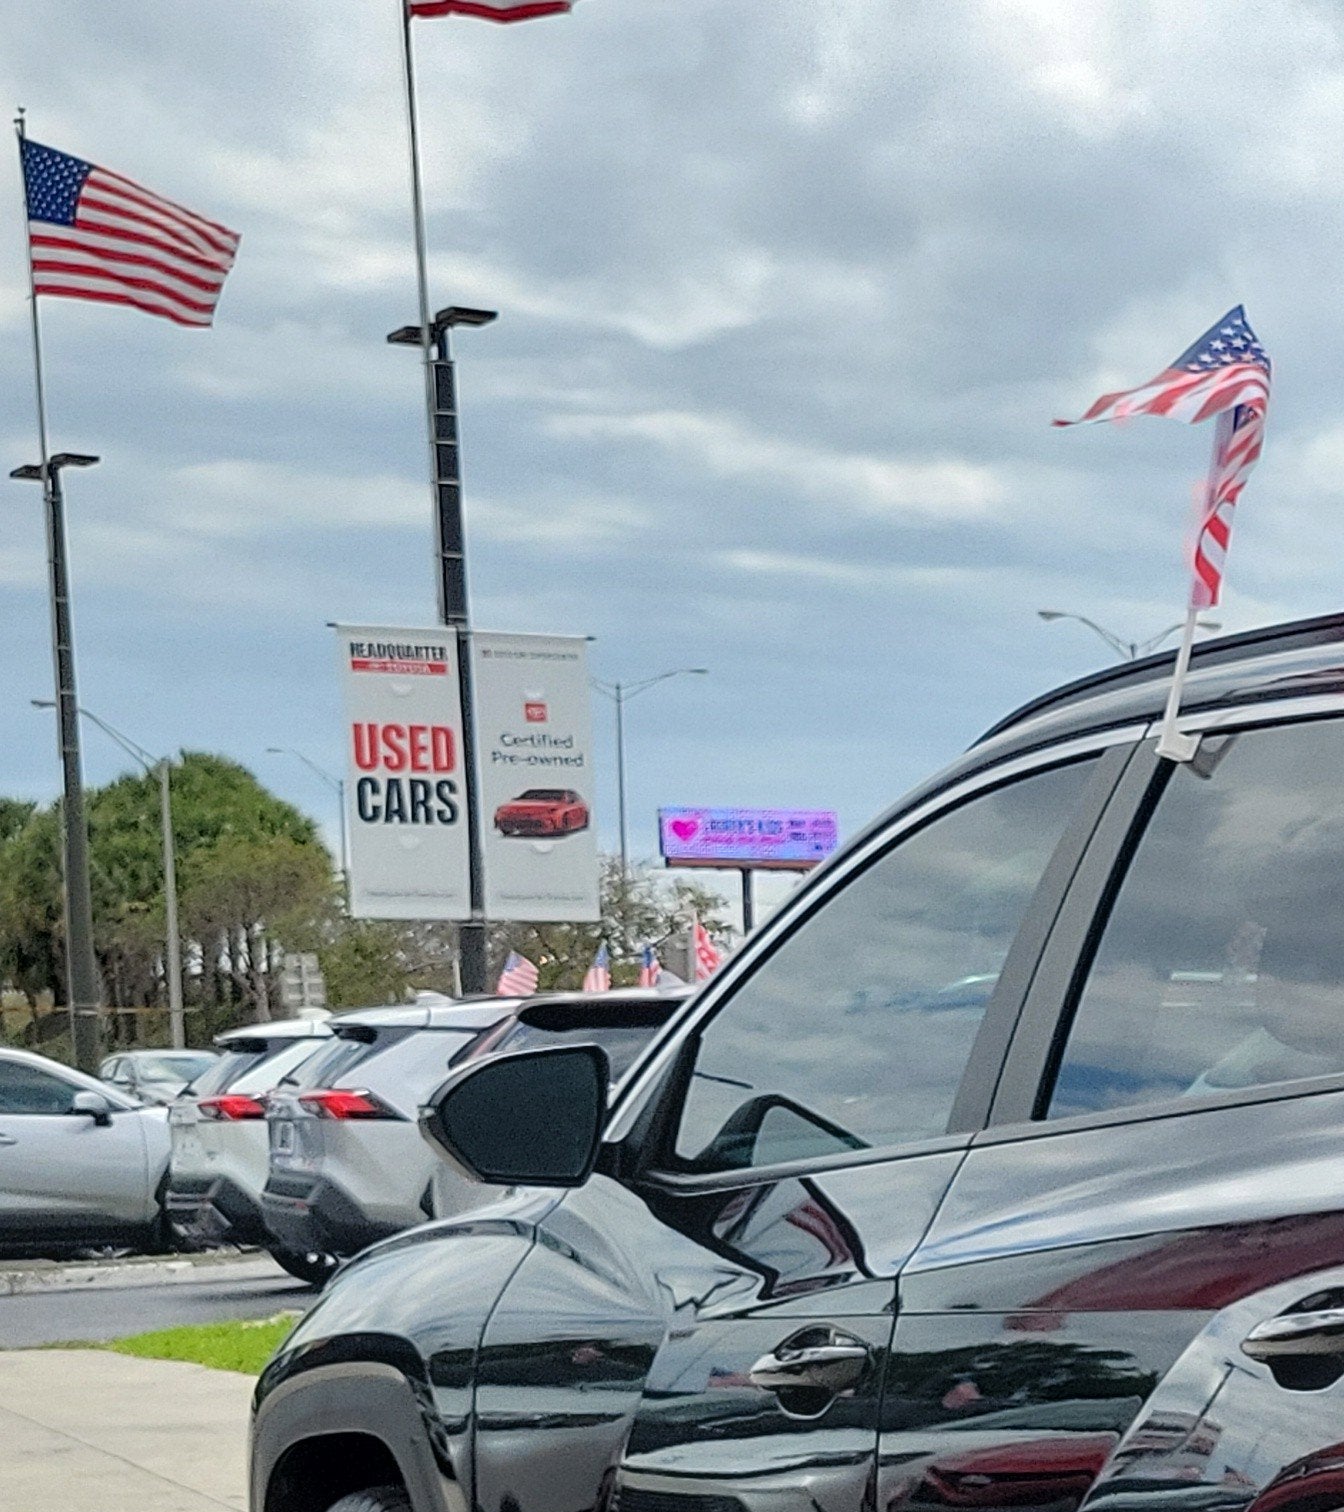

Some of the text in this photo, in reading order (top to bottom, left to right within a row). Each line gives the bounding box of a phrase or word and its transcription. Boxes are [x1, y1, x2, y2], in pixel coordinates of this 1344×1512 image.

[352, 722, 455, 773] USED
[500, 733, 574, 749] Certified
[491, 750, 585, 767] Pre-owned
[356, 776, 460, 826] CARS
